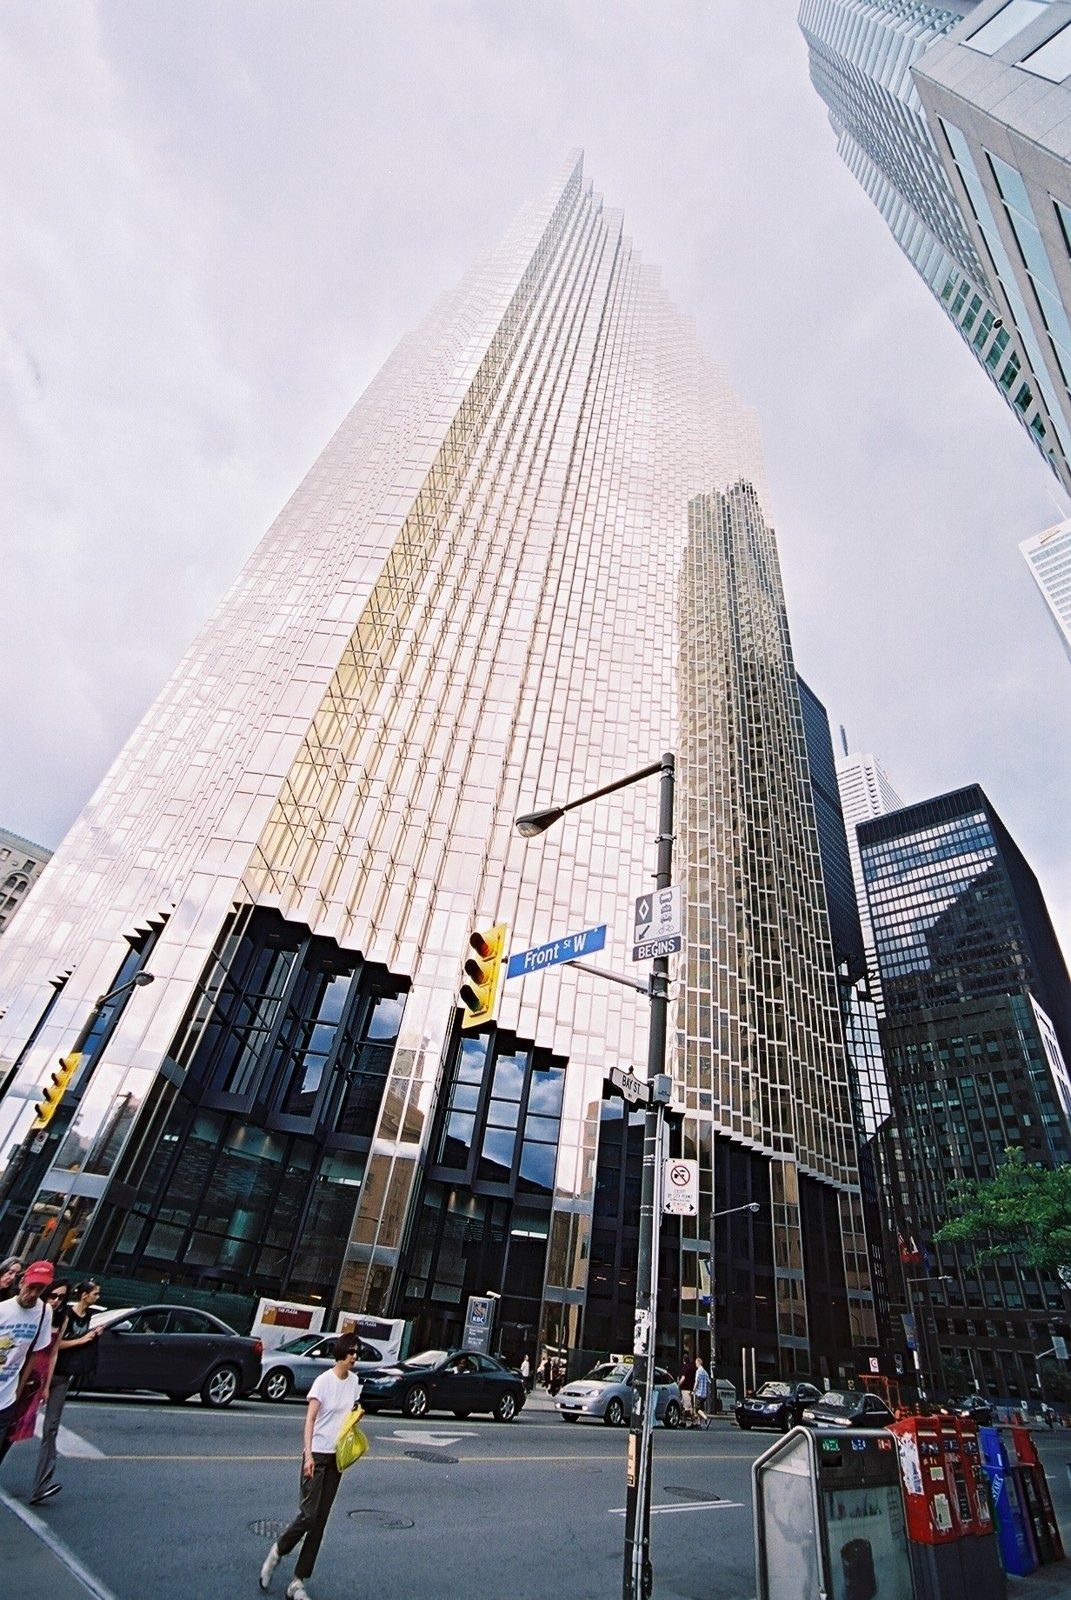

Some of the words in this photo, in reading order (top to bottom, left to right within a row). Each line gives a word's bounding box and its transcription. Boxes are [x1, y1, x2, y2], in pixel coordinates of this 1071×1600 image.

[524, 944, 560, 969] Front
[563, 941, 571, 950] St
[573, 933, 587, 952] W
[638, 940, 676, 957] BEGINS
[622, 1075, 633, 1090] BAY
